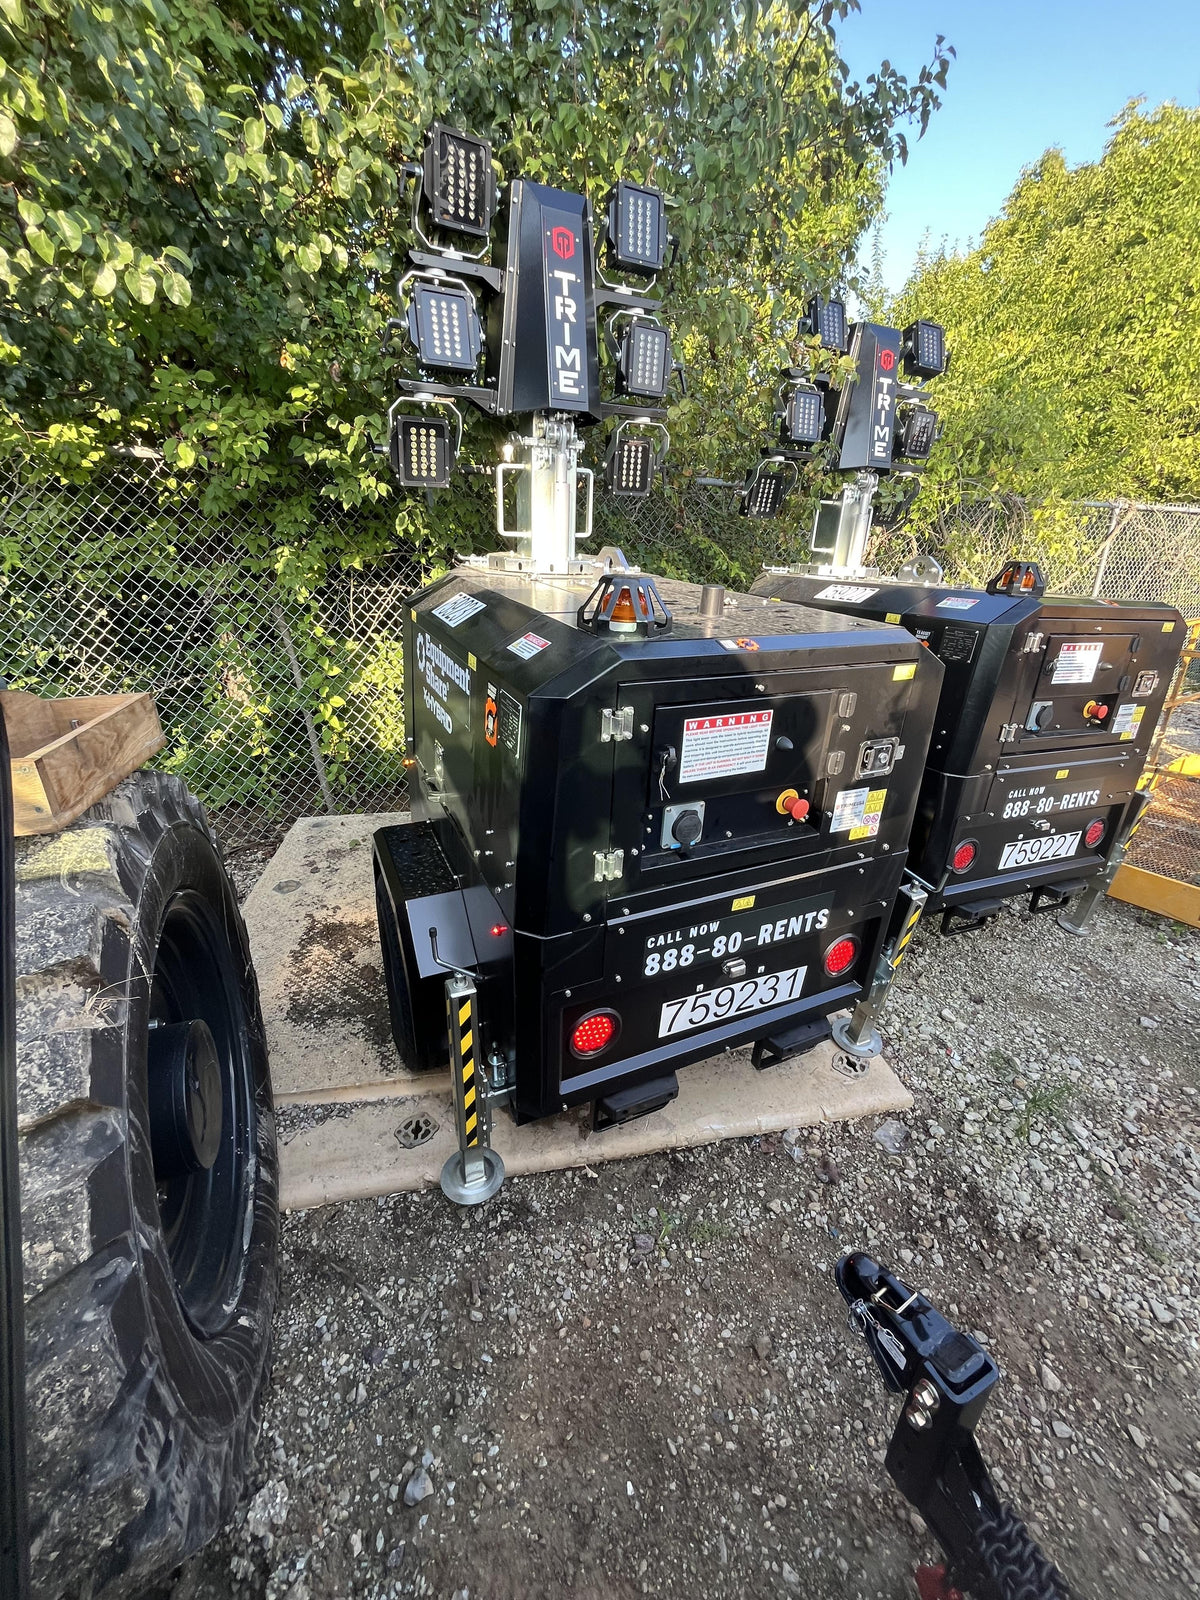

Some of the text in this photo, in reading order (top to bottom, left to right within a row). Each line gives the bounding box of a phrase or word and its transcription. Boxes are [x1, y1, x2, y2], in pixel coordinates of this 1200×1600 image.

[554, 270, 582, 395] TRIME
[874, 377, 893, 458] TRIME
[425, 632, 470, 696] Equipment
[425, 660, 448, 703] Share
[688, 713, 769, 730] WARNING
[1003, 789, 1100, 819] 888-80-RENTS
[1008, 786, 1046, 799] CALL NOW
[1003, 832, 1080, 867] 759227
[644, 908, 830, 977] 888-80-RENTS
[647, 920, 720, 949] CALL NOW
[665, 968, 800, 1034] 759231
